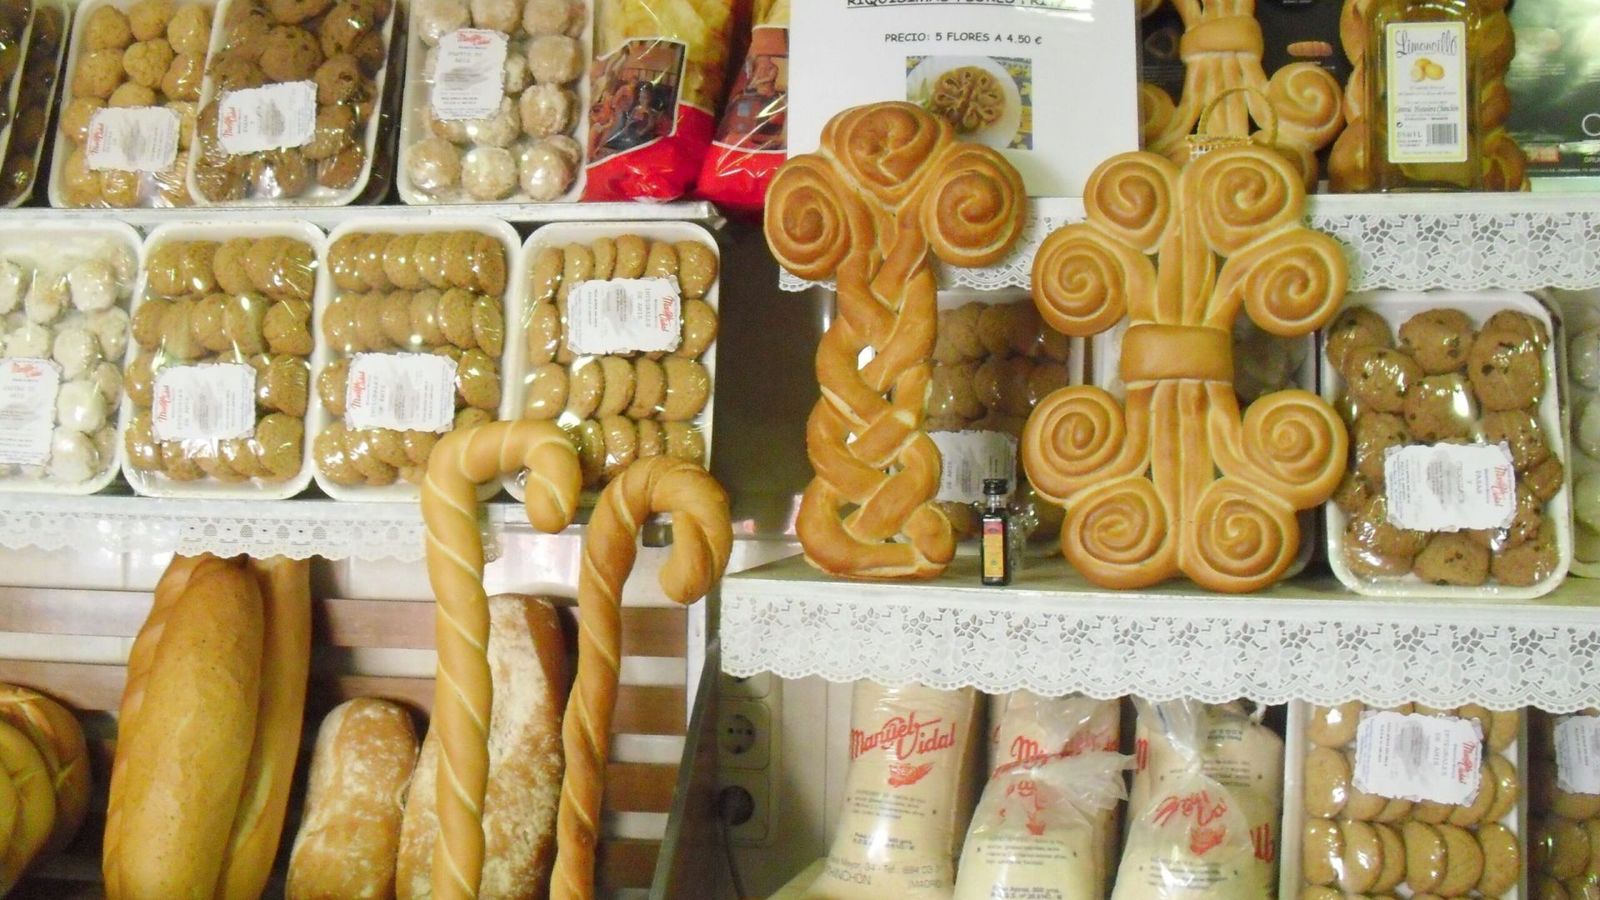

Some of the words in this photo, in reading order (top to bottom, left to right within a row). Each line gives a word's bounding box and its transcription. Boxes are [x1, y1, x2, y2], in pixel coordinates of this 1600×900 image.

[885, 32, 931, 42] PRECIO:
[935, 32, 943, 41] 5
[947, 32, 990, 42] FLORES
[994, 34, 1002, 42] A
[1007, 34, 1031, 44] 4.50
[1034, 36, 1043, 45] €
[849, 710, 918, 761] Manuel
[896, 718, 956, 760] Vidal
